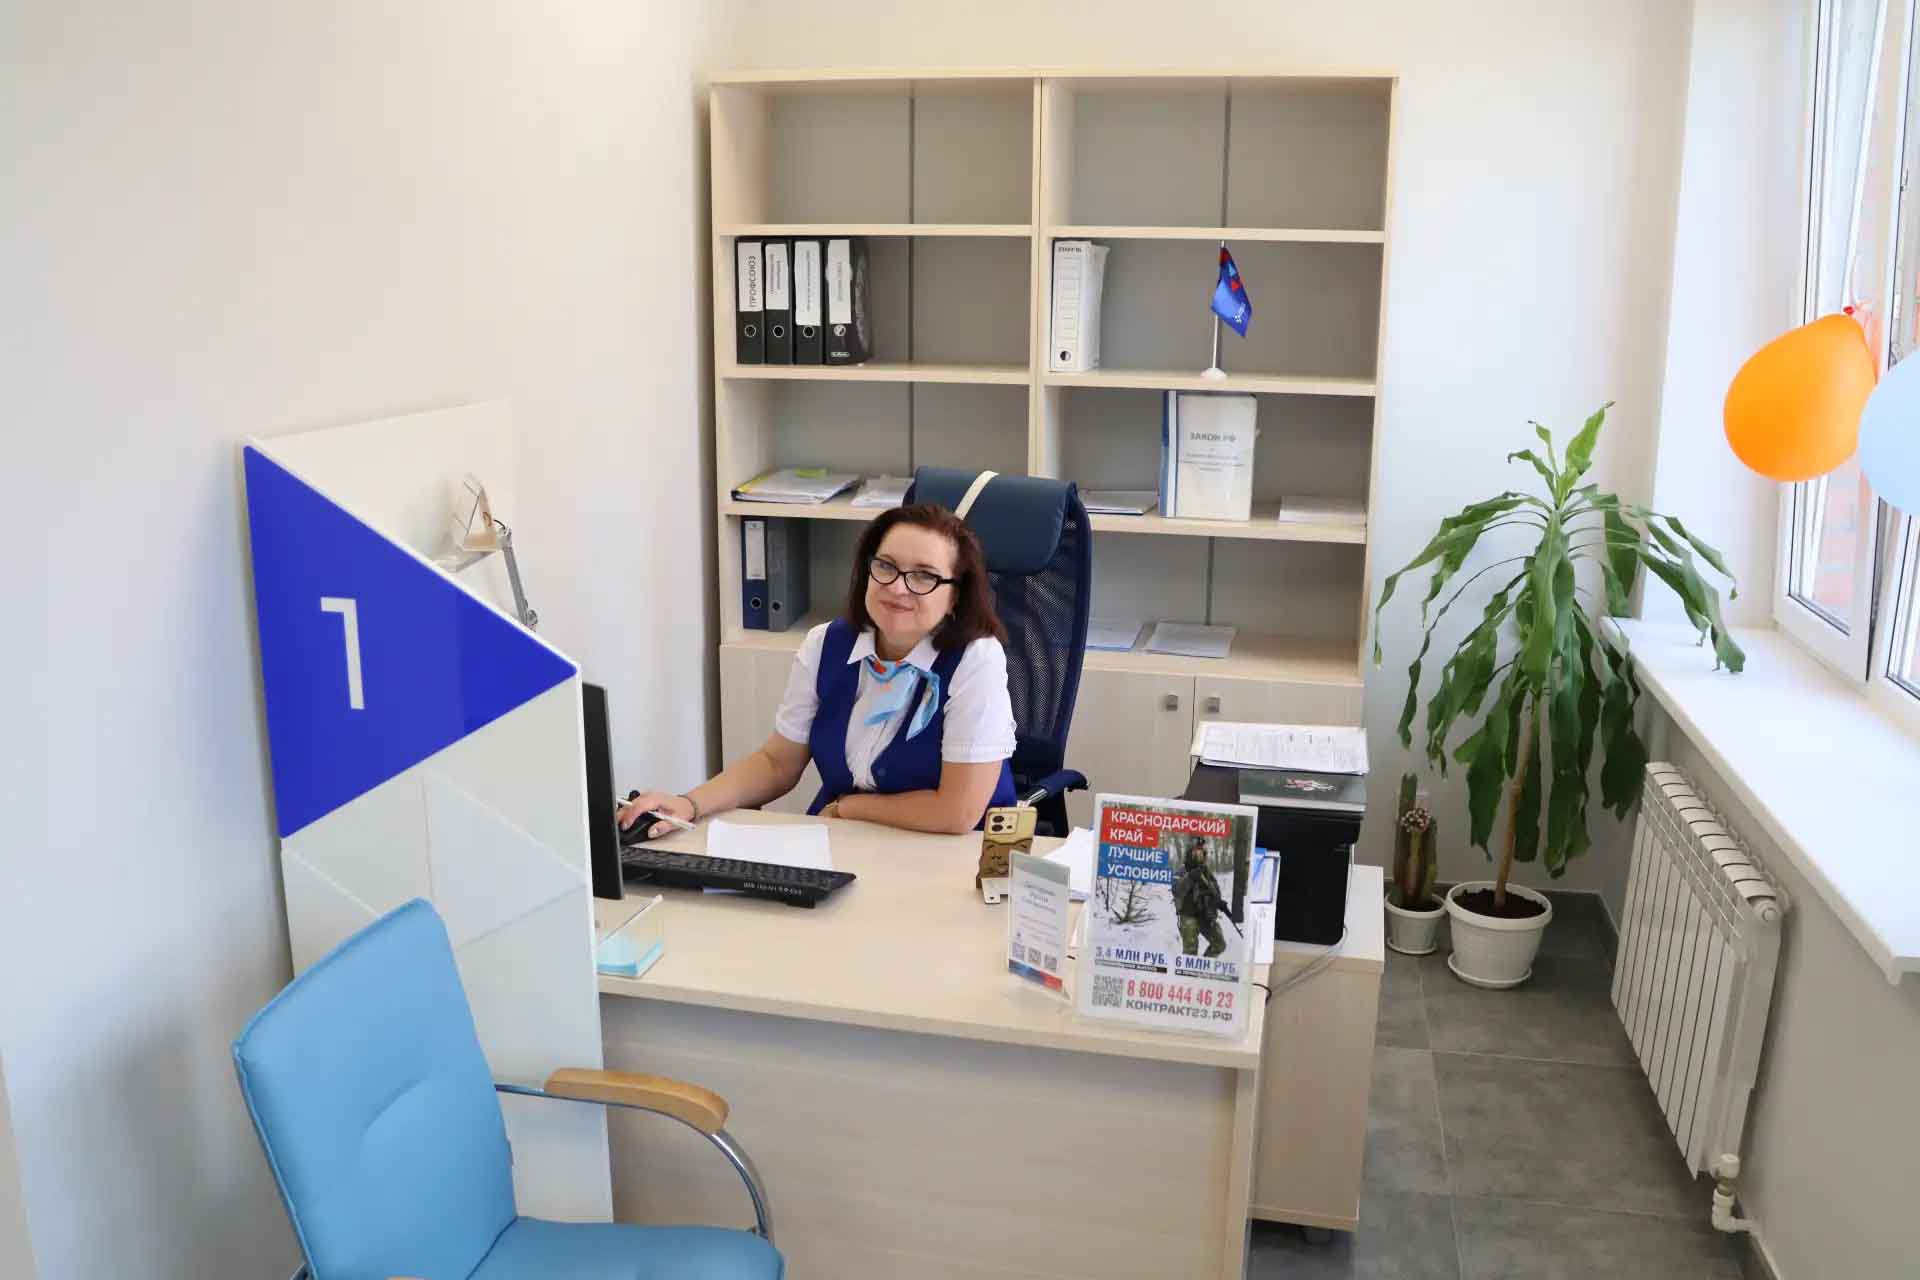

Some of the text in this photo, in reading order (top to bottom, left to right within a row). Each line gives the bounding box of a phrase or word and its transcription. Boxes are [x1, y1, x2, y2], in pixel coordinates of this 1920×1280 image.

[747, 254, 757, 309] ПРОФСОЮЗ
[320, 597, 365, 710] 1
[1111, 810, 1226, 834] КРАСНОДАРСКИЙ
[1110, 828, 1143, 843] КРАЙ
[1108, 846, 1164, 864] ЛУЧШИЕ
[1107, 864, 1172, 882] УСЛОВИЯ!
[1115, 948, 1140, 962] МЛН
[1143, 952, 1168, 966] РУБ.
[1175, 956, 1182, 967] 6
[1185, 957, 1210, 970] МЛН
[1127, 980, 1234, 1009] 8 800 444 46 23
[1126, 999, 1233, 1022] КОНТРАКТ23.РФ
